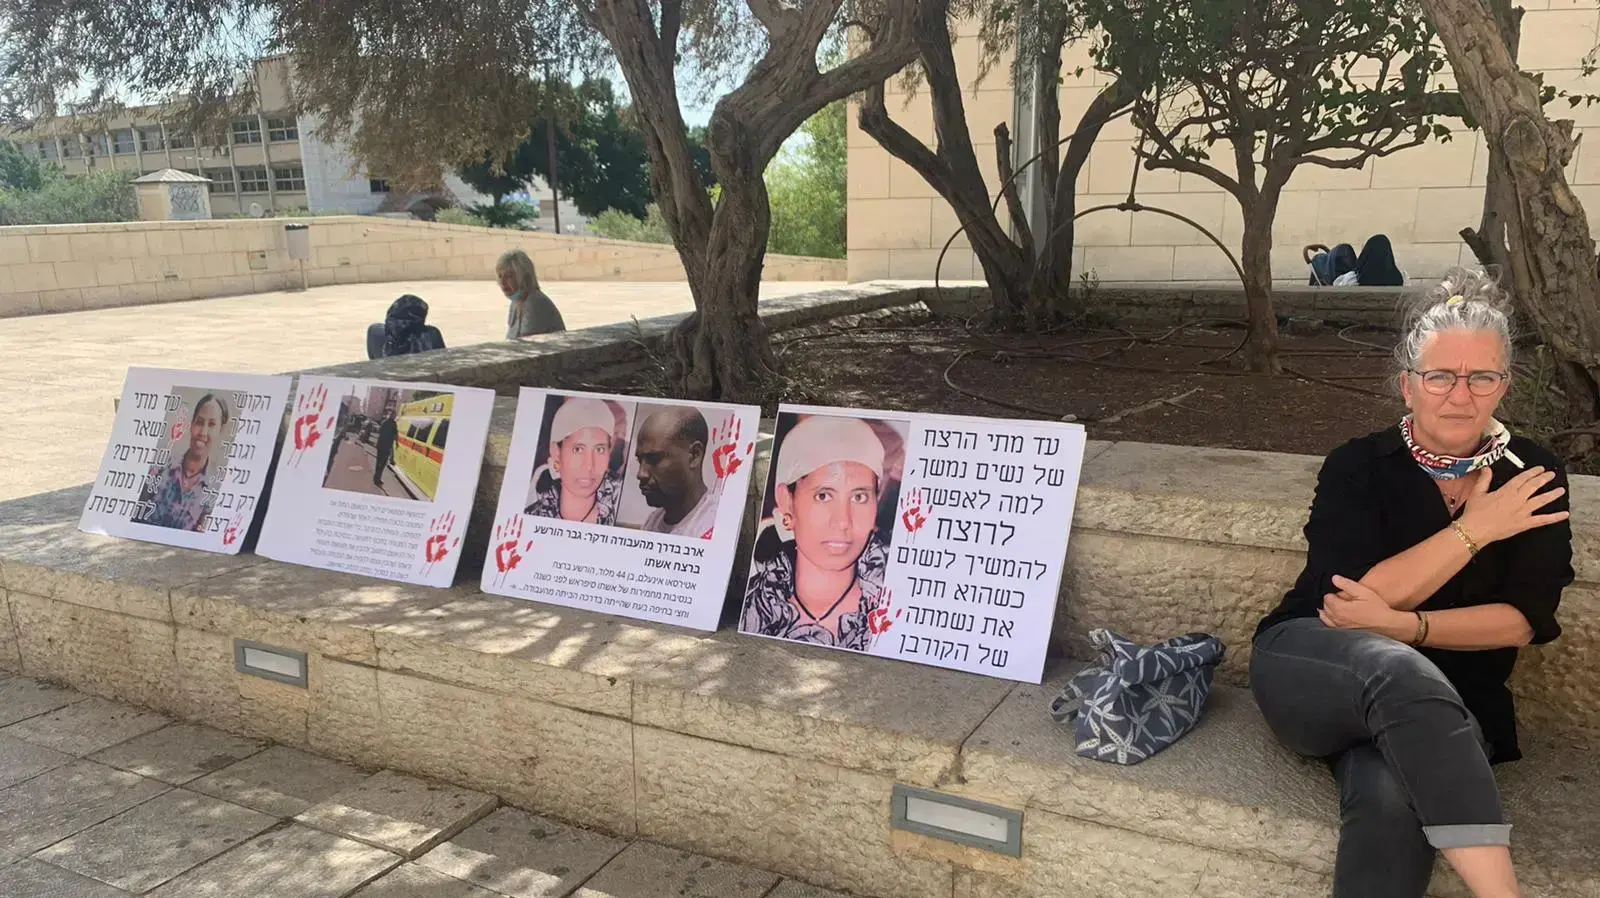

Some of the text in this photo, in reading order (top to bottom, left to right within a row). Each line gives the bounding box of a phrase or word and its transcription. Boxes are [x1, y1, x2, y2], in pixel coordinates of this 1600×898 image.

[134, 391, 182, 412] עד מתי
[232, 392, 272, 412] הקושי
[133, 418, 167, 438] נשאר
[223, 441, 256, 460] וגובר
[923, 428, 1060, 456] עד מתי הרצח
[104, 470, 136, 489] ממה
[910, 457, 1065, 487] של נשים נמשך,
[88, 495, 156, 520] להתרפות
[236, 494, 256, 512] רק
[921, 486, 1044, 515] למה לאפשר
[533, 524, 563, 538] הורשע
[565, 529, 582, 541] גבר
[936, 517, 1016, 546] לרוצח
[610, 536, 654, 550] מהעבודה
[656, 541, 681, 555] בדרך
[683, 545, 705, 557] ארב
[552, 560, 571, 570] ברצח
[572, 564, 595, 574] הורשע
[644, 557, 701, 574] ברצח אשתו
[896, 546, 1047, 581] להמשיך לנשום
[616, 570, 626, 578] 44
[626, 572, 635, 582] בן
[597, 581, 617, 592] אשתו
[618, 584, 629, 594] של
[630, 587, 662, 599] מחמירות
[907, 576, 1025, 609] כשהוא חתך
[632, 602, 648, 611] בעת
[663, 592, 693, 604] בנסיבות
[649, 605, 673, 616] בחיפה
[905, 605, 1015, 639] את נשמתה
[898, 633, 1009, 668] של הקורבן
